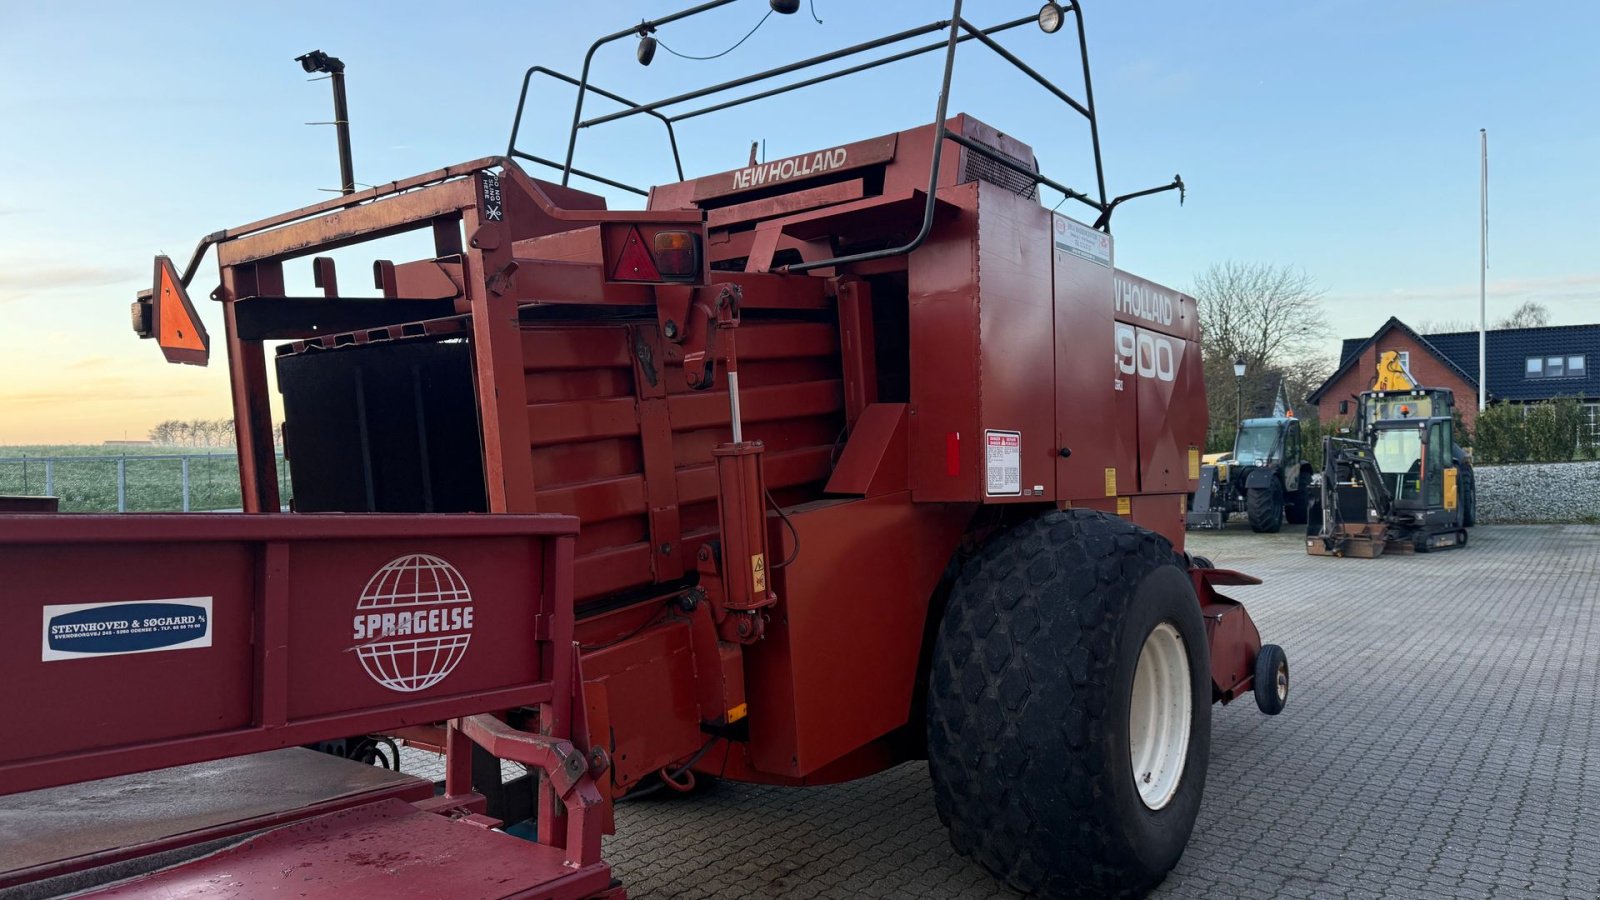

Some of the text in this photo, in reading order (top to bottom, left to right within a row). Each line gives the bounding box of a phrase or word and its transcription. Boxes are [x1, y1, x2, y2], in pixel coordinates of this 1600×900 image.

[494, 176, 499, 187] DO
[732, 148, 847, 190] NEW HOLLAND
[1122, 281, 1172, 327] HOLLAND
[1115, 326, 1174, 382] 900
[51, 620, 129, 635] STEVNHOVED
[131, 619, 140, 628] &
[143, 615, 196, 627] SØGAARD
[54, 631, 101, 640] SVENDBORGVEJ
[353, 606, 474, 640] SPRAGELSE
